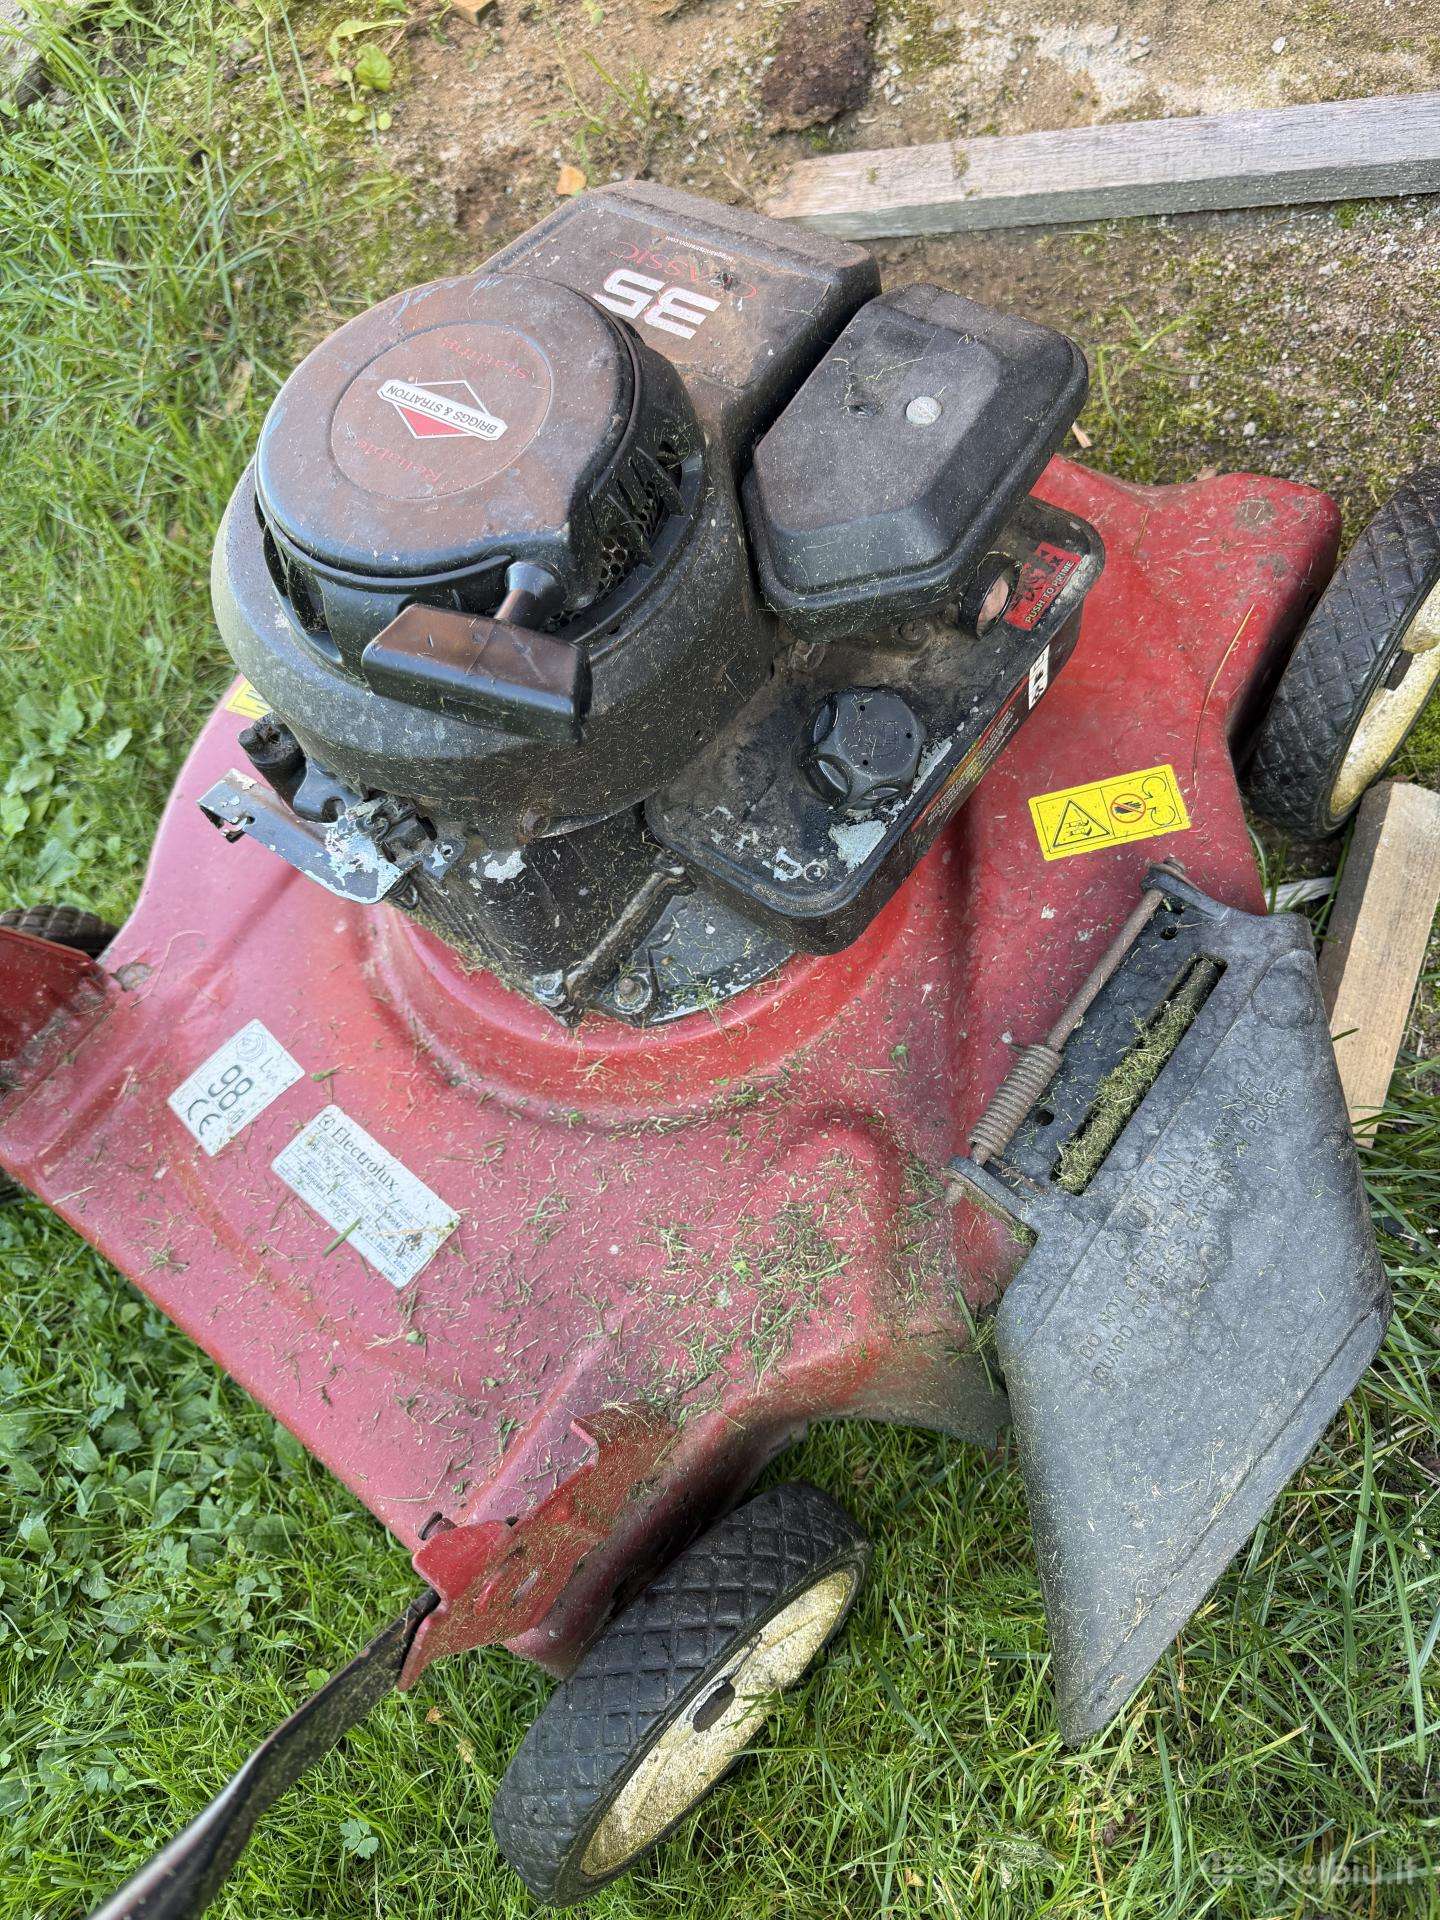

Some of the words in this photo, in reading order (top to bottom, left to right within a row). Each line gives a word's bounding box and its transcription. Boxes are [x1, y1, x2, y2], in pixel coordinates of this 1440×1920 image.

[592, 269, 721, 340] 35
[387, 384, 444, 412] STRATTON
[443, 405, 452, 417] &
[452, 410, 498, 434] BRIGGS
[1025, 600, 1046, 624] PUSH
[1043, 587, 1055, 599] TO
[1052, 560, 1075, 587] PRIME
[207, 1064, 254, 1111] 98
[331, 1127, 399, 1193] Electrolux
[1089, 1321, 1137, 1383] GUARD
[1129, 1292, 1154, 1320] OR
[1148, 1232, 1193, 1290] GRASS
[1243, 1079, 1288, 1136] PLACE
[1104, 1147, 1187, 1263] CAUTION
[1077, 1330, 1104, 1362] DO
[1095, 1289, 1129, 1330] NOT
[1120, 1212, 1178, 1292] OPERATE
[1169, 1150, 1217, 1212] MOWER
